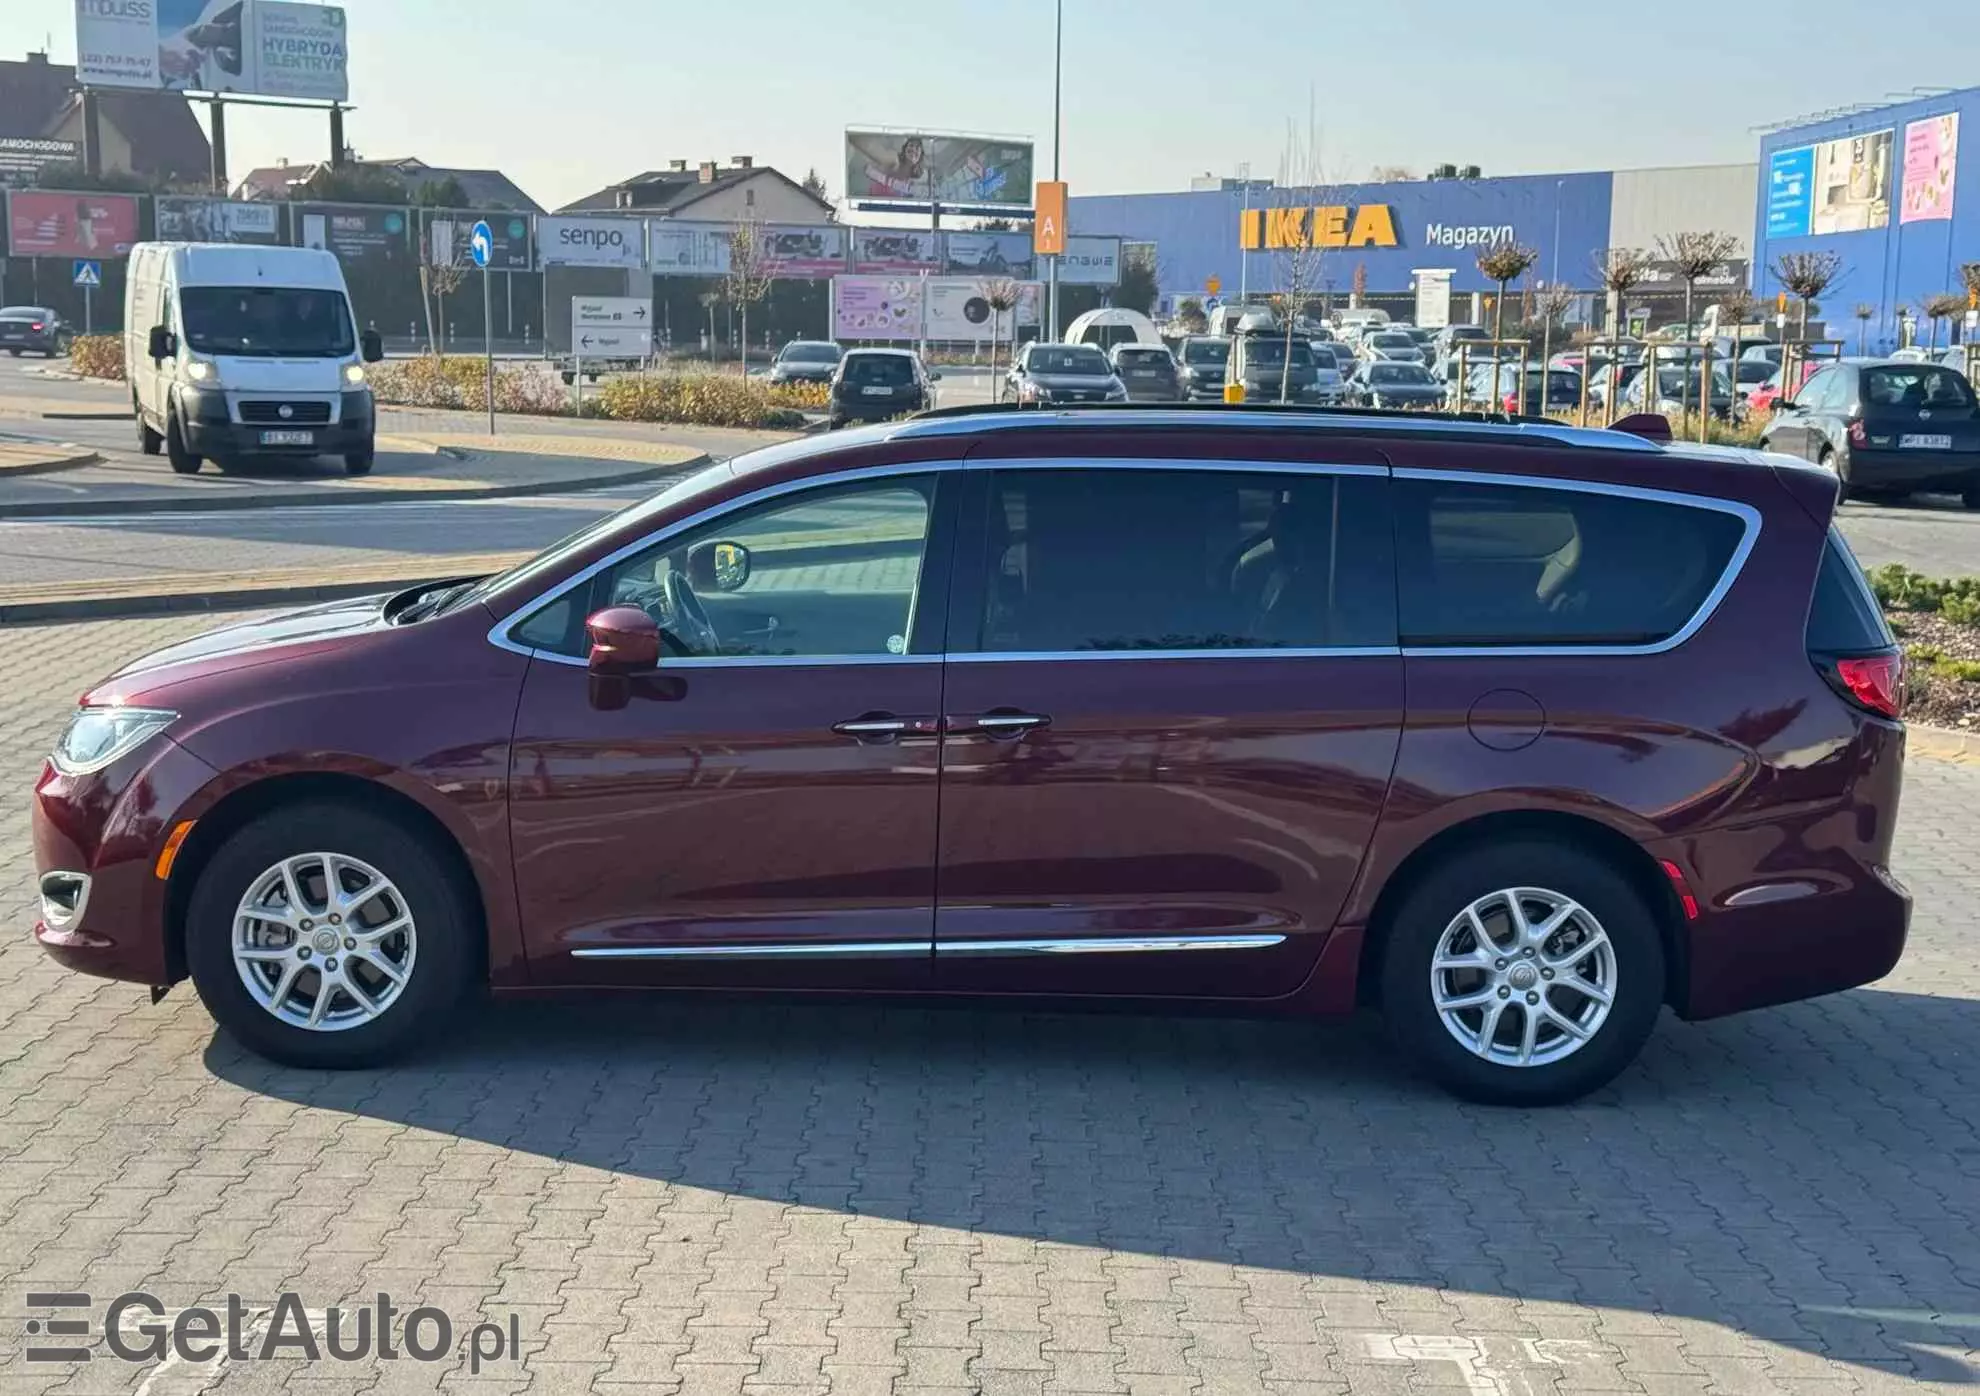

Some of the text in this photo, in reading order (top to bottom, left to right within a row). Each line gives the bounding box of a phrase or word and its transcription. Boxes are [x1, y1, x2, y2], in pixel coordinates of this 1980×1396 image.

[263, 37, 343, 57] HYBRYDA
[1042, 215, 1056, 236] A
[1240, 204, 1397, 249] IKEA
[1426, 223, 1514, 250] Magazyn
[560, 228, 623, 250] senpo
